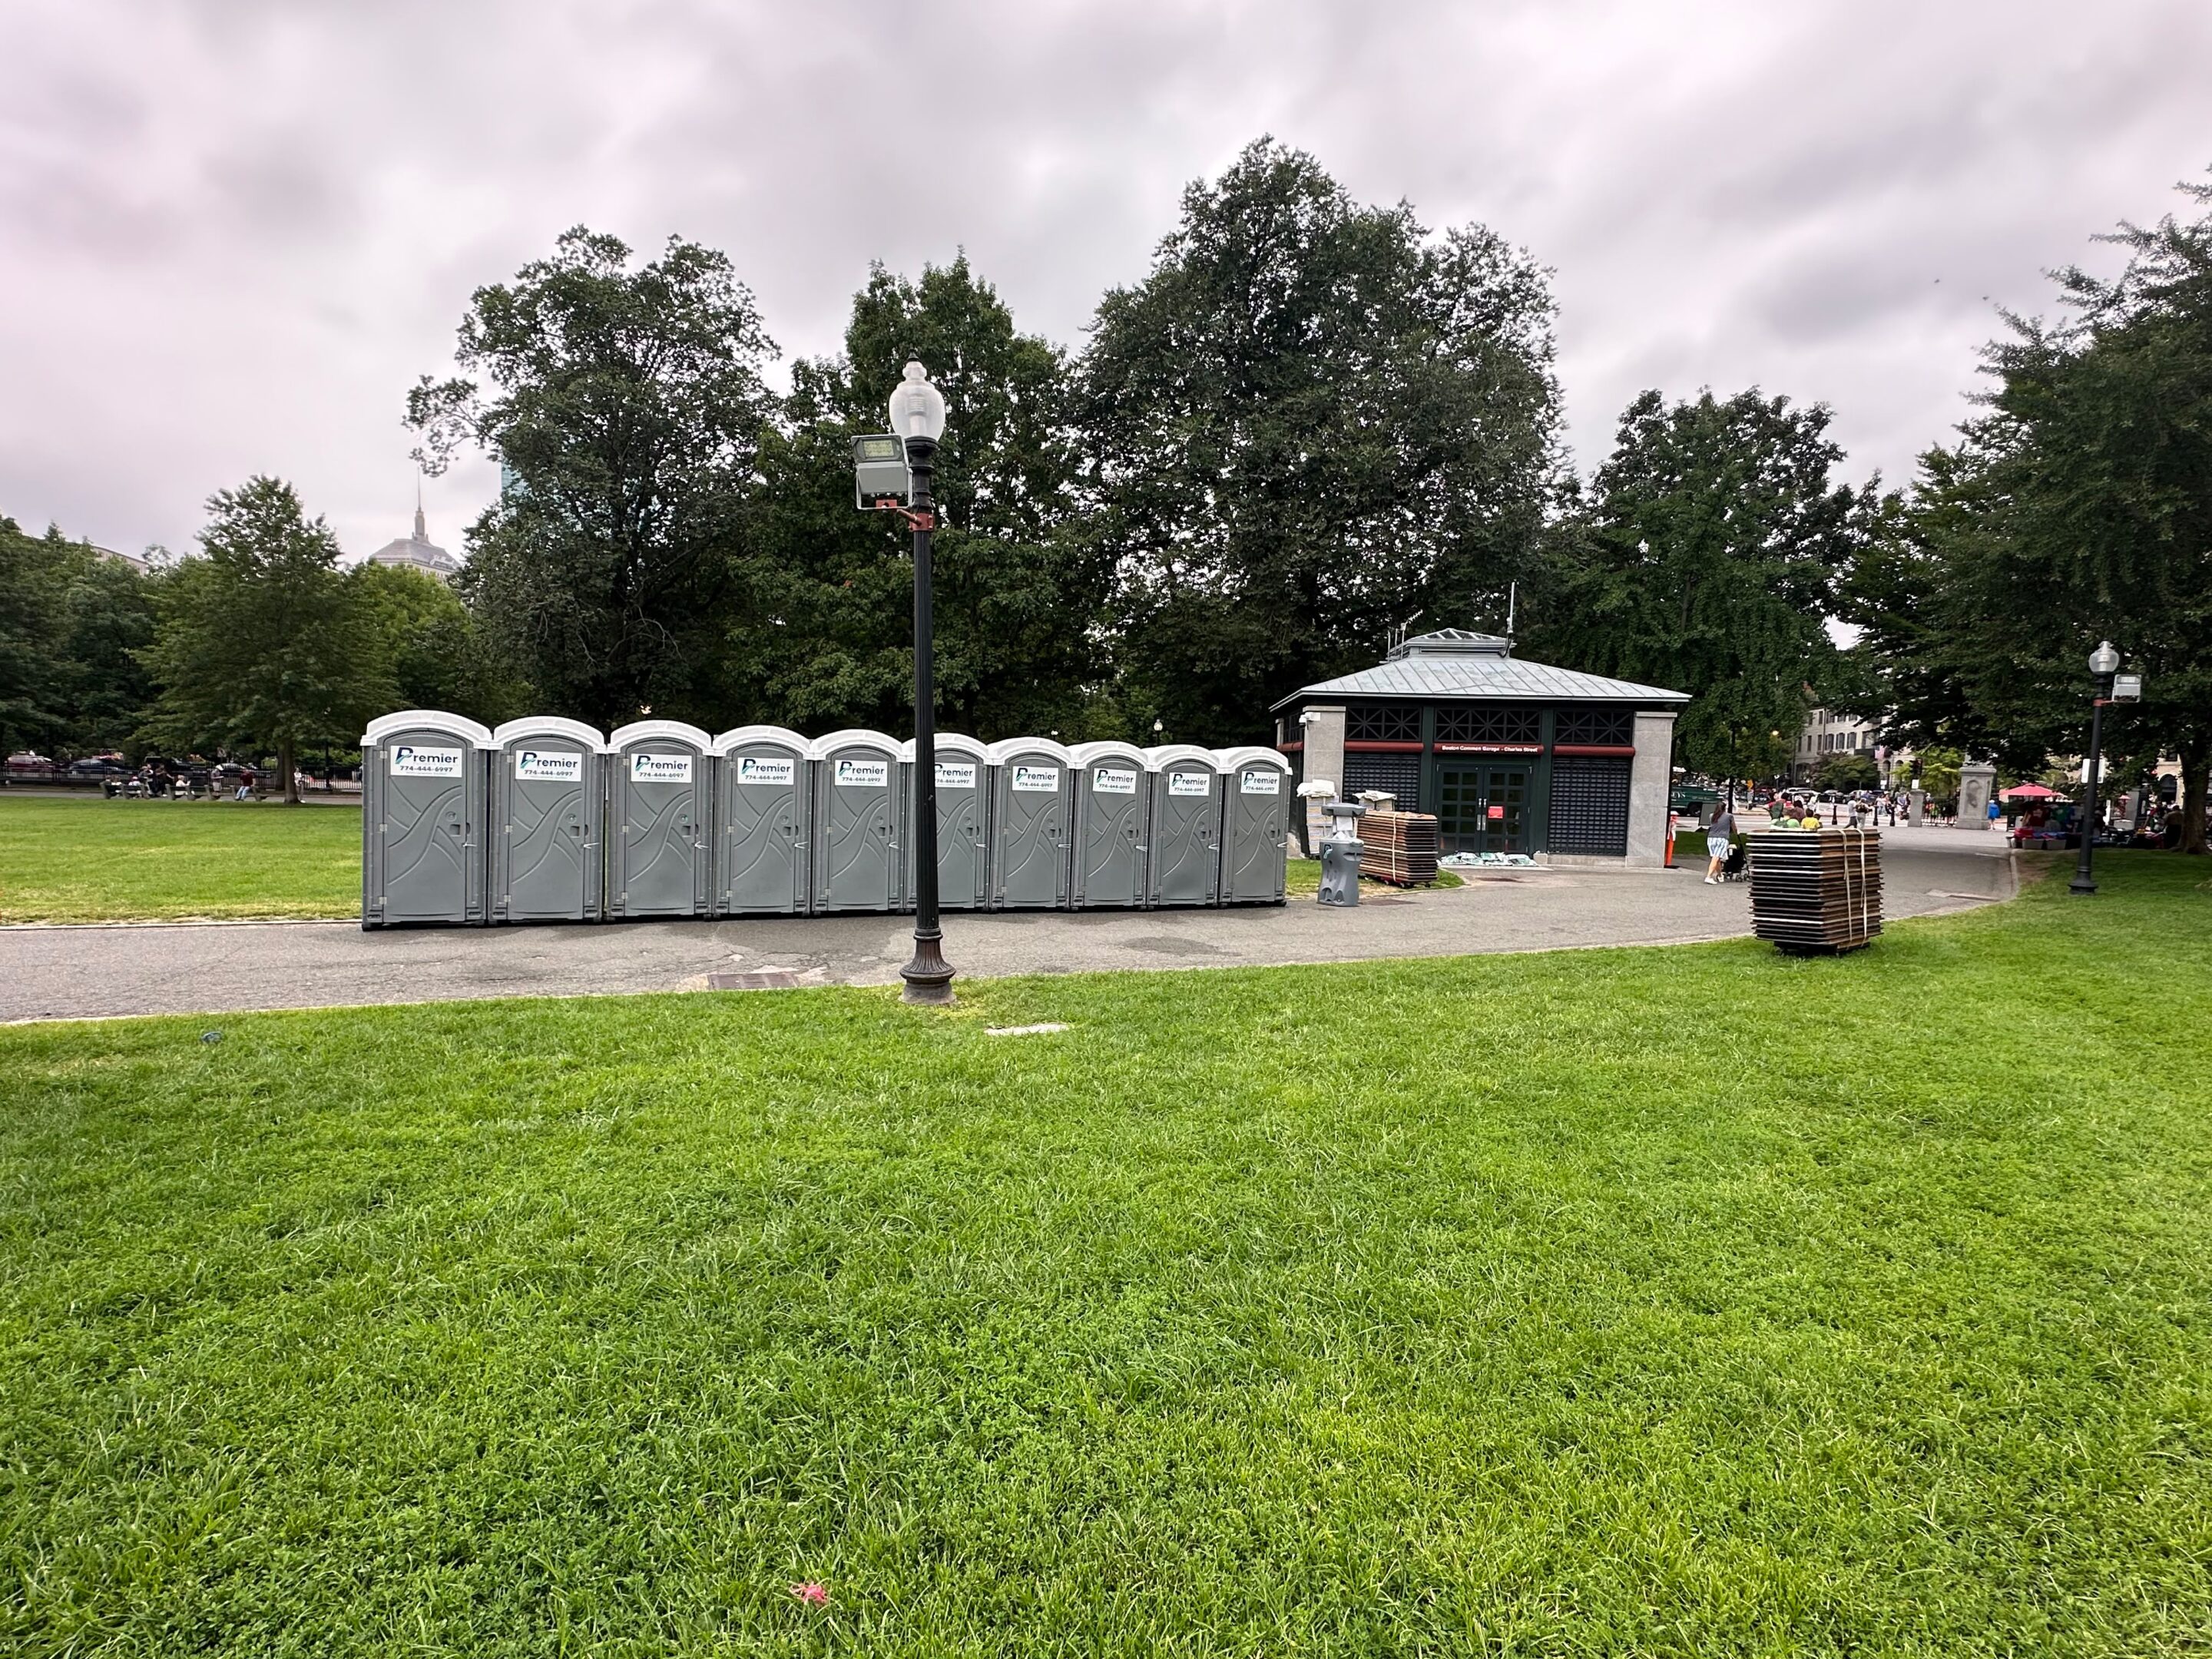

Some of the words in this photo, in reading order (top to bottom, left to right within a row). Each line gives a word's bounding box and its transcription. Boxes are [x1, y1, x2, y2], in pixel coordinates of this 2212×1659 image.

[395, 747, 458, 764] Premier
[520, 752, 578, 768] Premier
[635, 755, 688, 771] Premier
[742, 759, 791, 774] Premier
[839, 761, 885, 776] Premier
[1015, 767, 1056, 781] Premier
[1096, 770, 1134, 783] Premier
[1172, 773, 1207, 786] Premier
[1243, 772, 1277, 785] Premier
